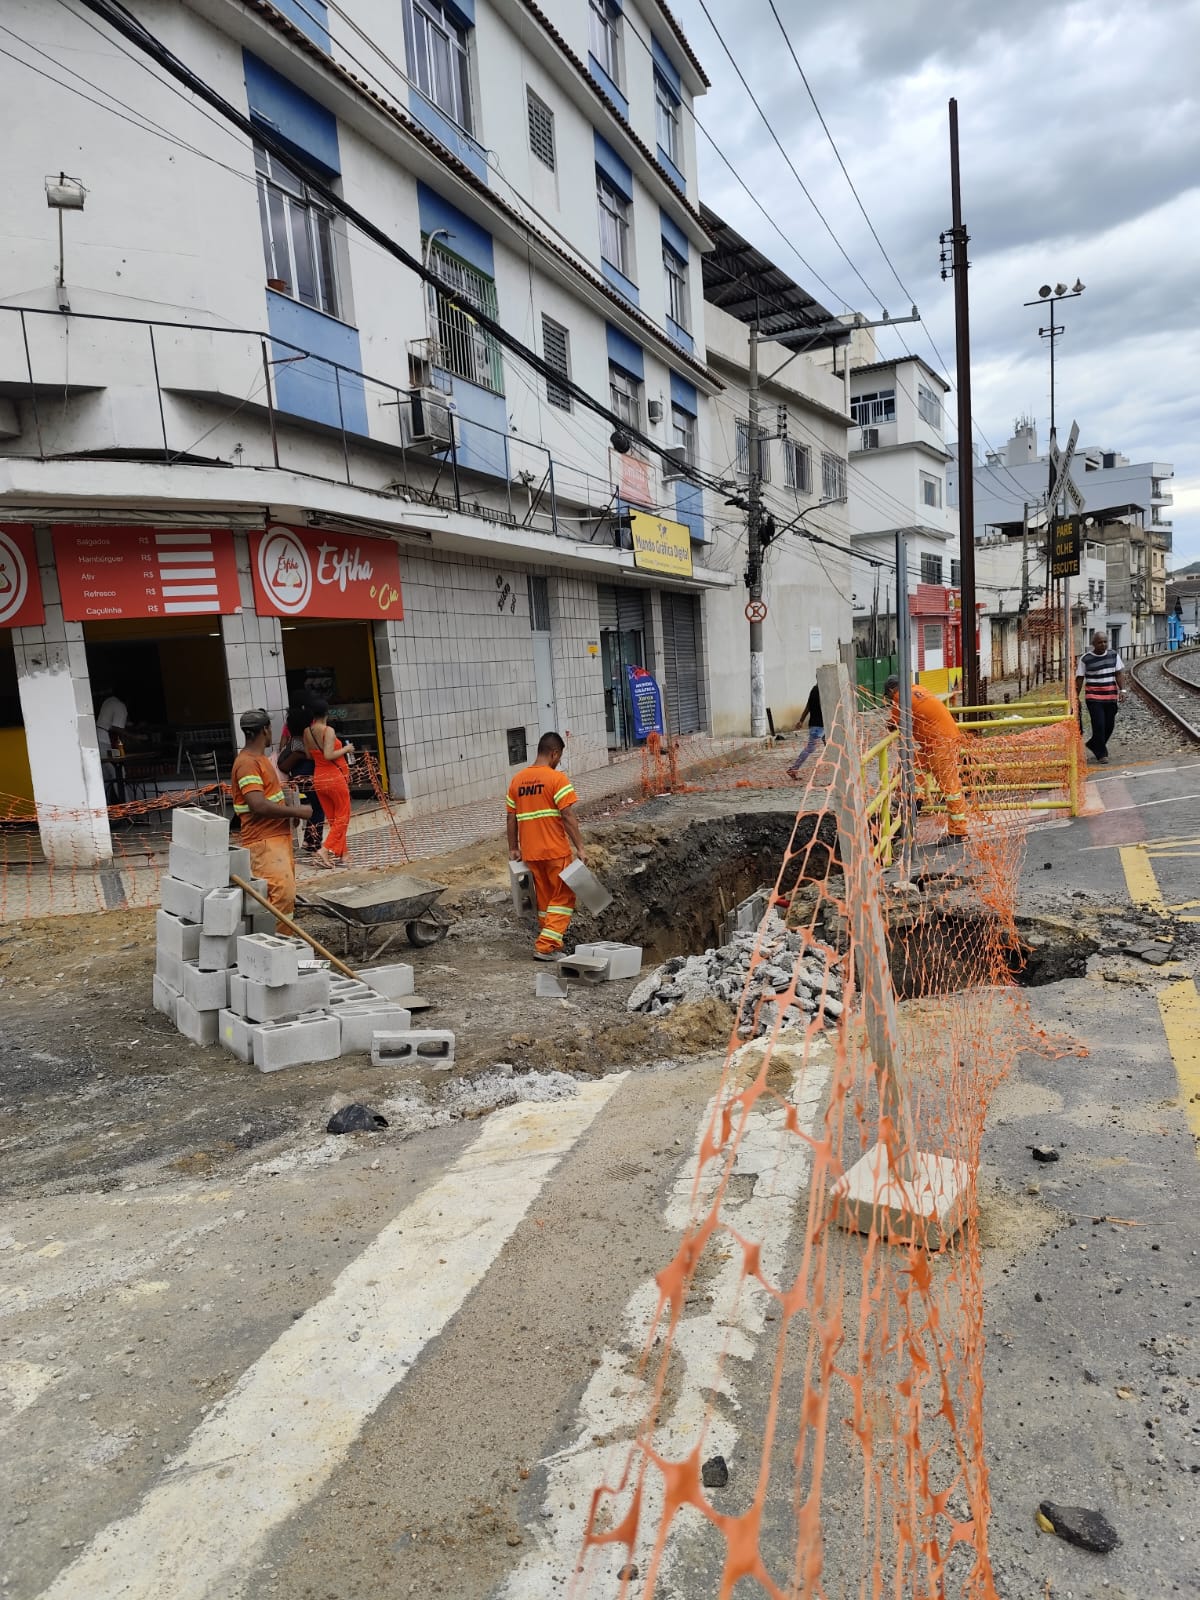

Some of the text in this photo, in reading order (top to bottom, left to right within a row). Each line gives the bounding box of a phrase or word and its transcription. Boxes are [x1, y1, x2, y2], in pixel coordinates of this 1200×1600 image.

[1056, 522, 1073, 538] PARE
[76, 538, 110, 547] Salgados
[635, 534, 656, 552] Mundo
[673, 545, 690, 562] Digital
[1056, 541, 1073, 556] OLHE
[317, 541, 374, 593] Esfiha
[1053, 559, 1078, 575] ESCUTE
[83, 590, 116, 598] Refresco
[369, 583, 399, 610] e Cia
[518, 784, 545, 797] DNIT
